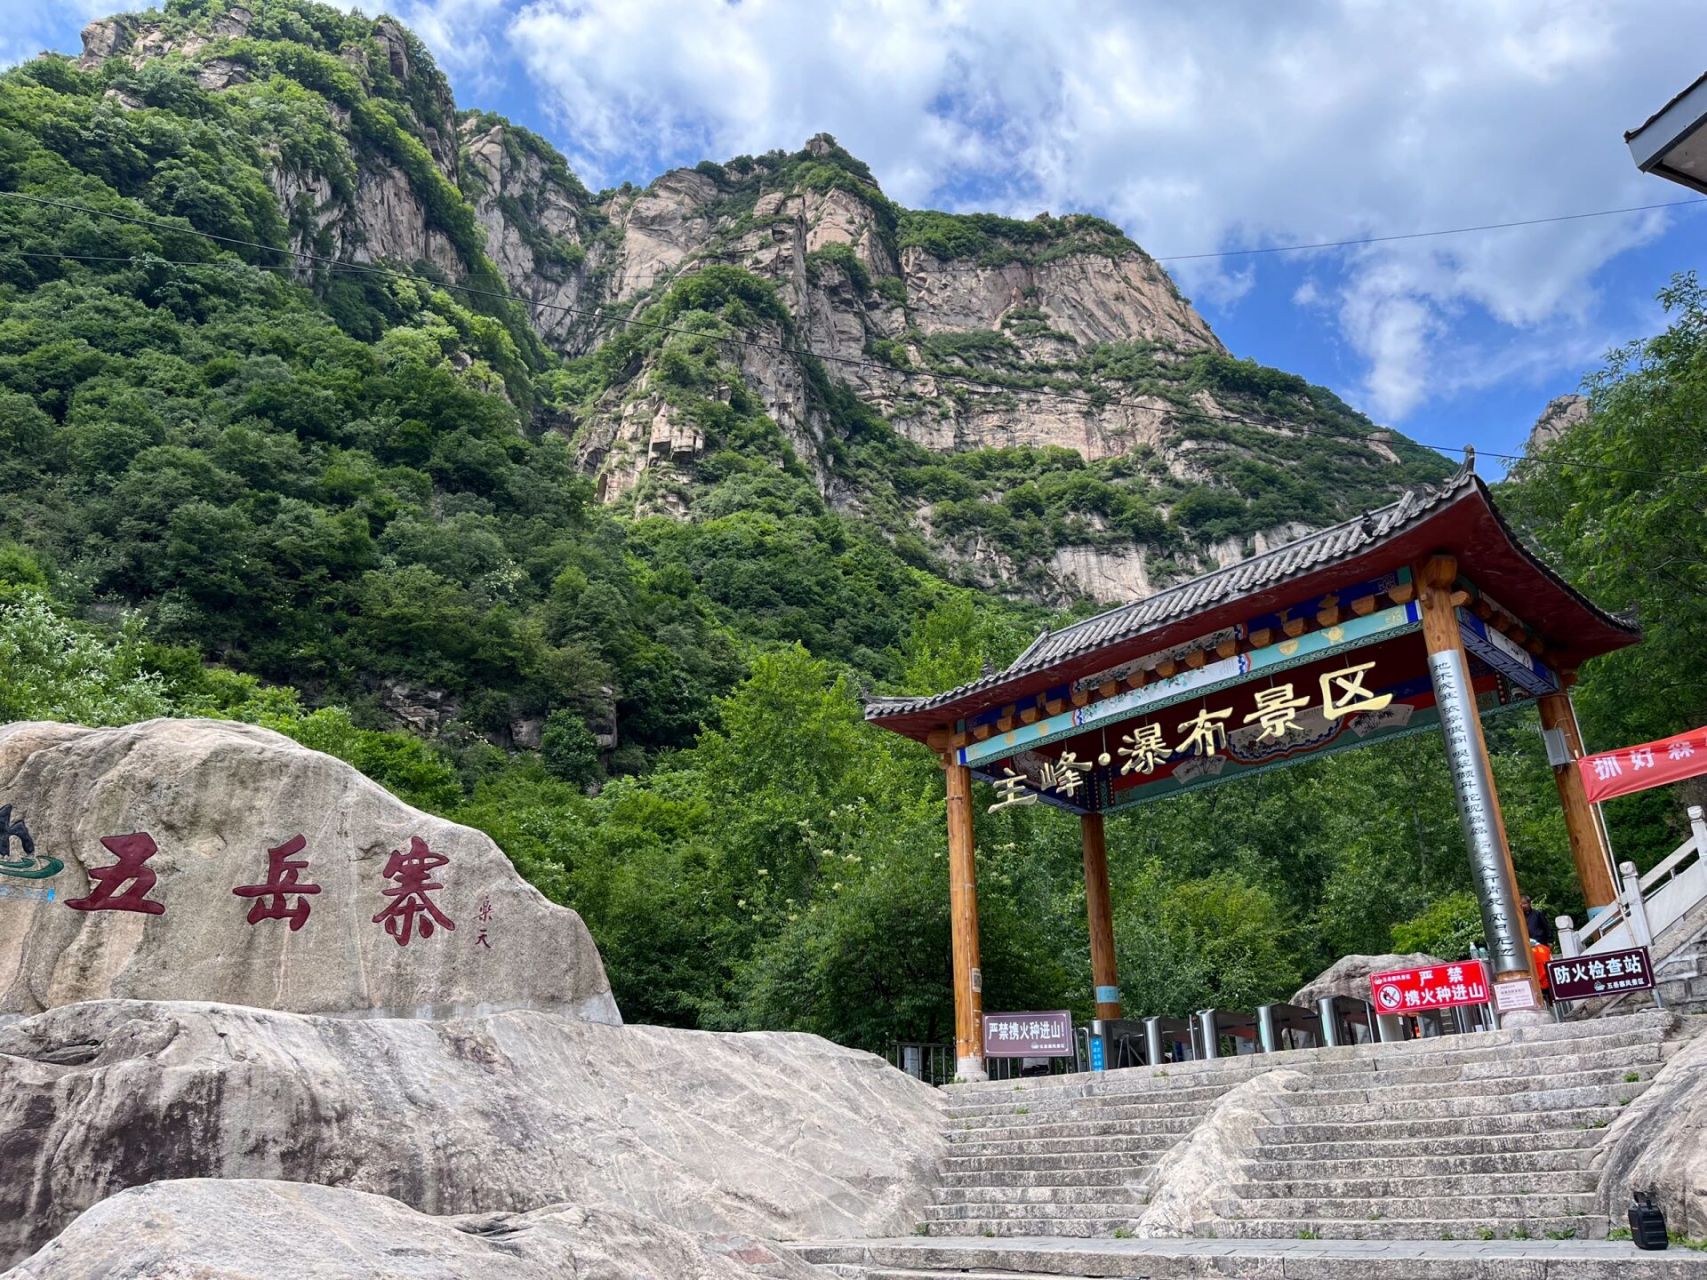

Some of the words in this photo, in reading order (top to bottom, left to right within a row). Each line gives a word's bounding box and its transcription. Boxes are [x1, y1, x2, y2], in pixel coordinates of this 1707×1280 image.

[1593, 734, 1707, 781] 抓好森
[63, 831, 457, 947] 五岳寨
[1418, 966, 1464, 987] 严禁
[1553, 954, 1643, 985] 防火检查站
[1404, 982, 1485, 1007] 携火种进山
[988, 1020, 1065, 1041] 严禁携火种进山!
